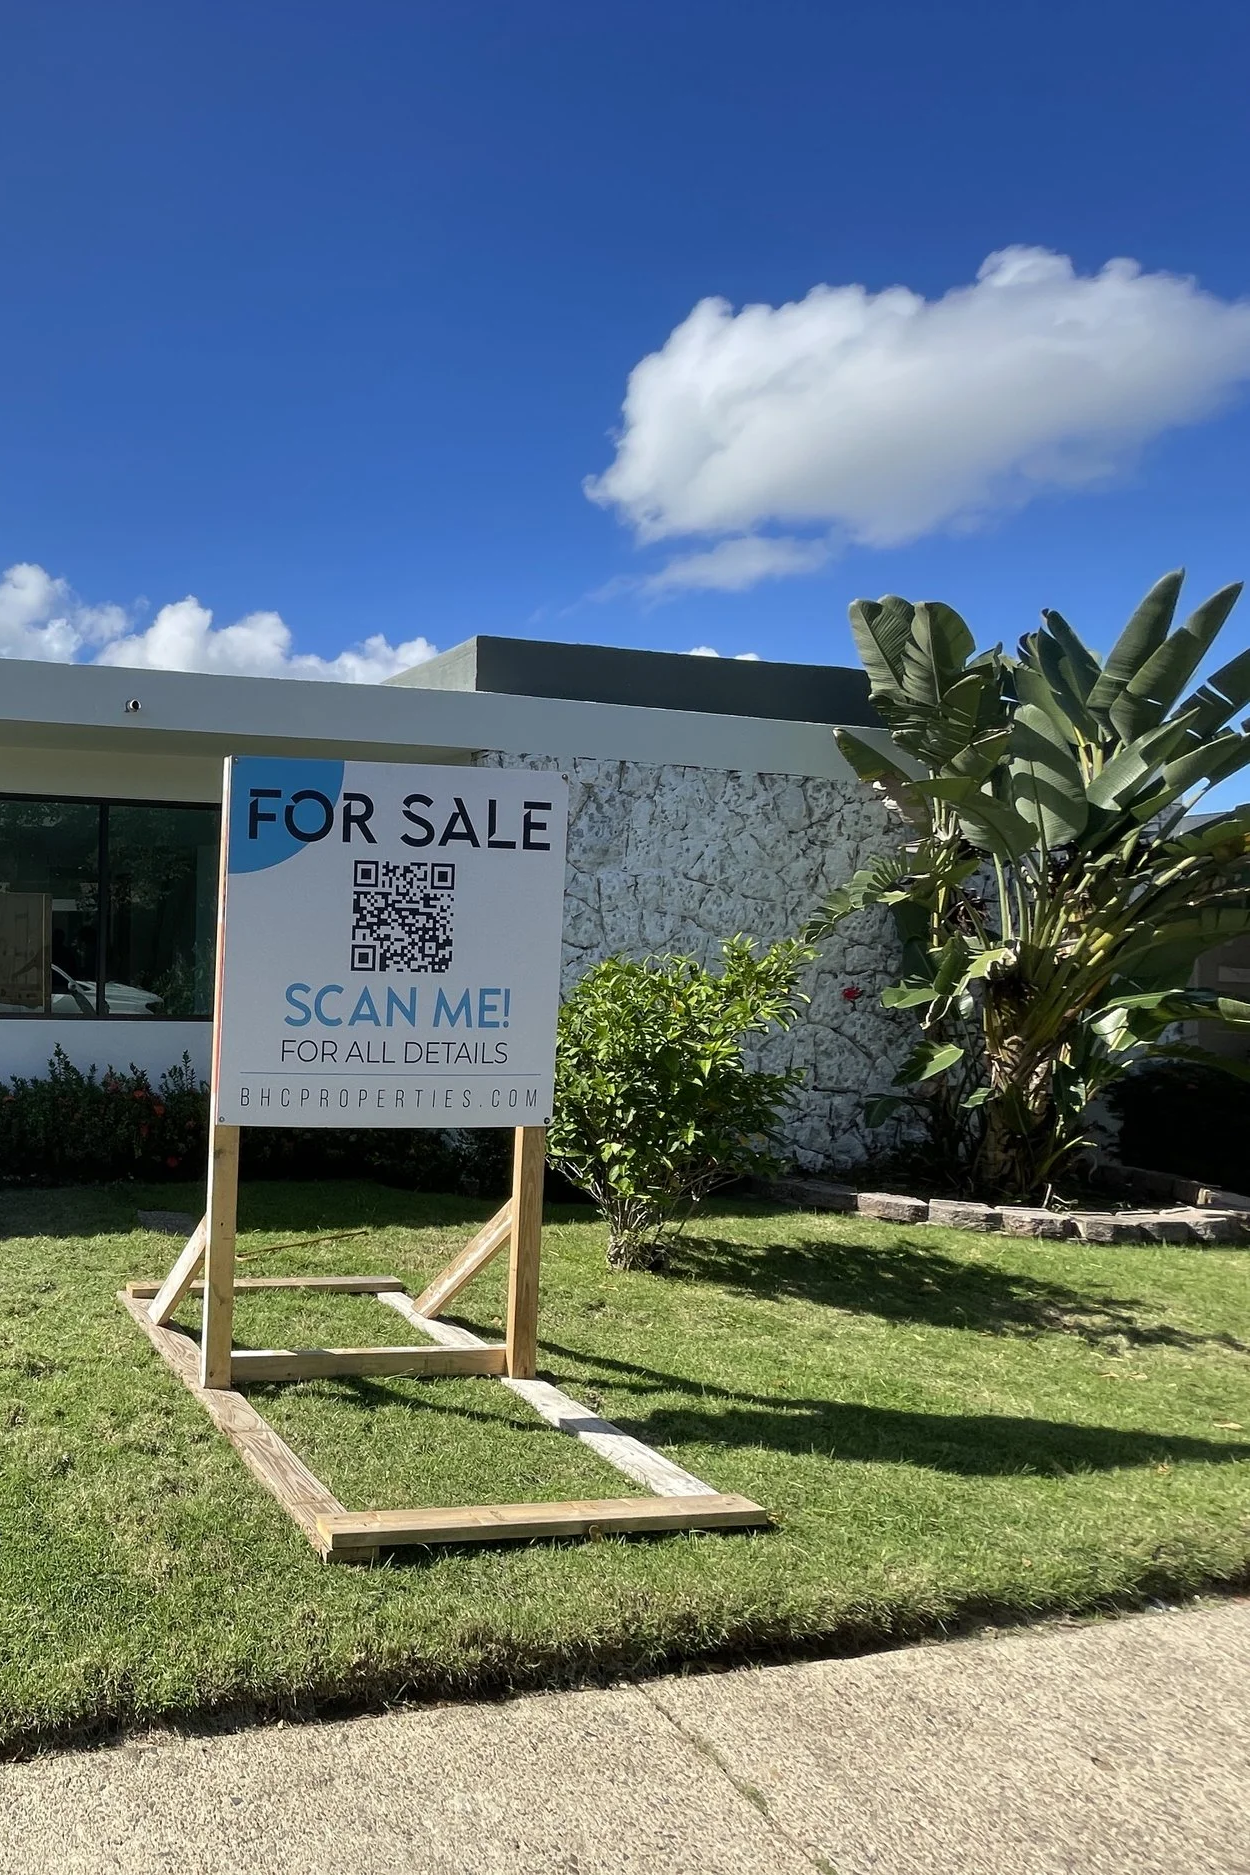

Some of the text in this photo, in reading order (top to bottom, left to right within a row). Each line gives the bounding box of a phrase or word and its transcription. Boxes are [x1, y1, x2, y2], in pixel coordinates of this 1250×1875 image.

[248, 788, 553, 852] FOR SALE
[283, 982, 511, 1029] SCAN ME!
[280, 1039, 508, 1065] FOR ALL DETAILS
[240, 1087, 538, 1108] BHCPROPERTIES.COM
